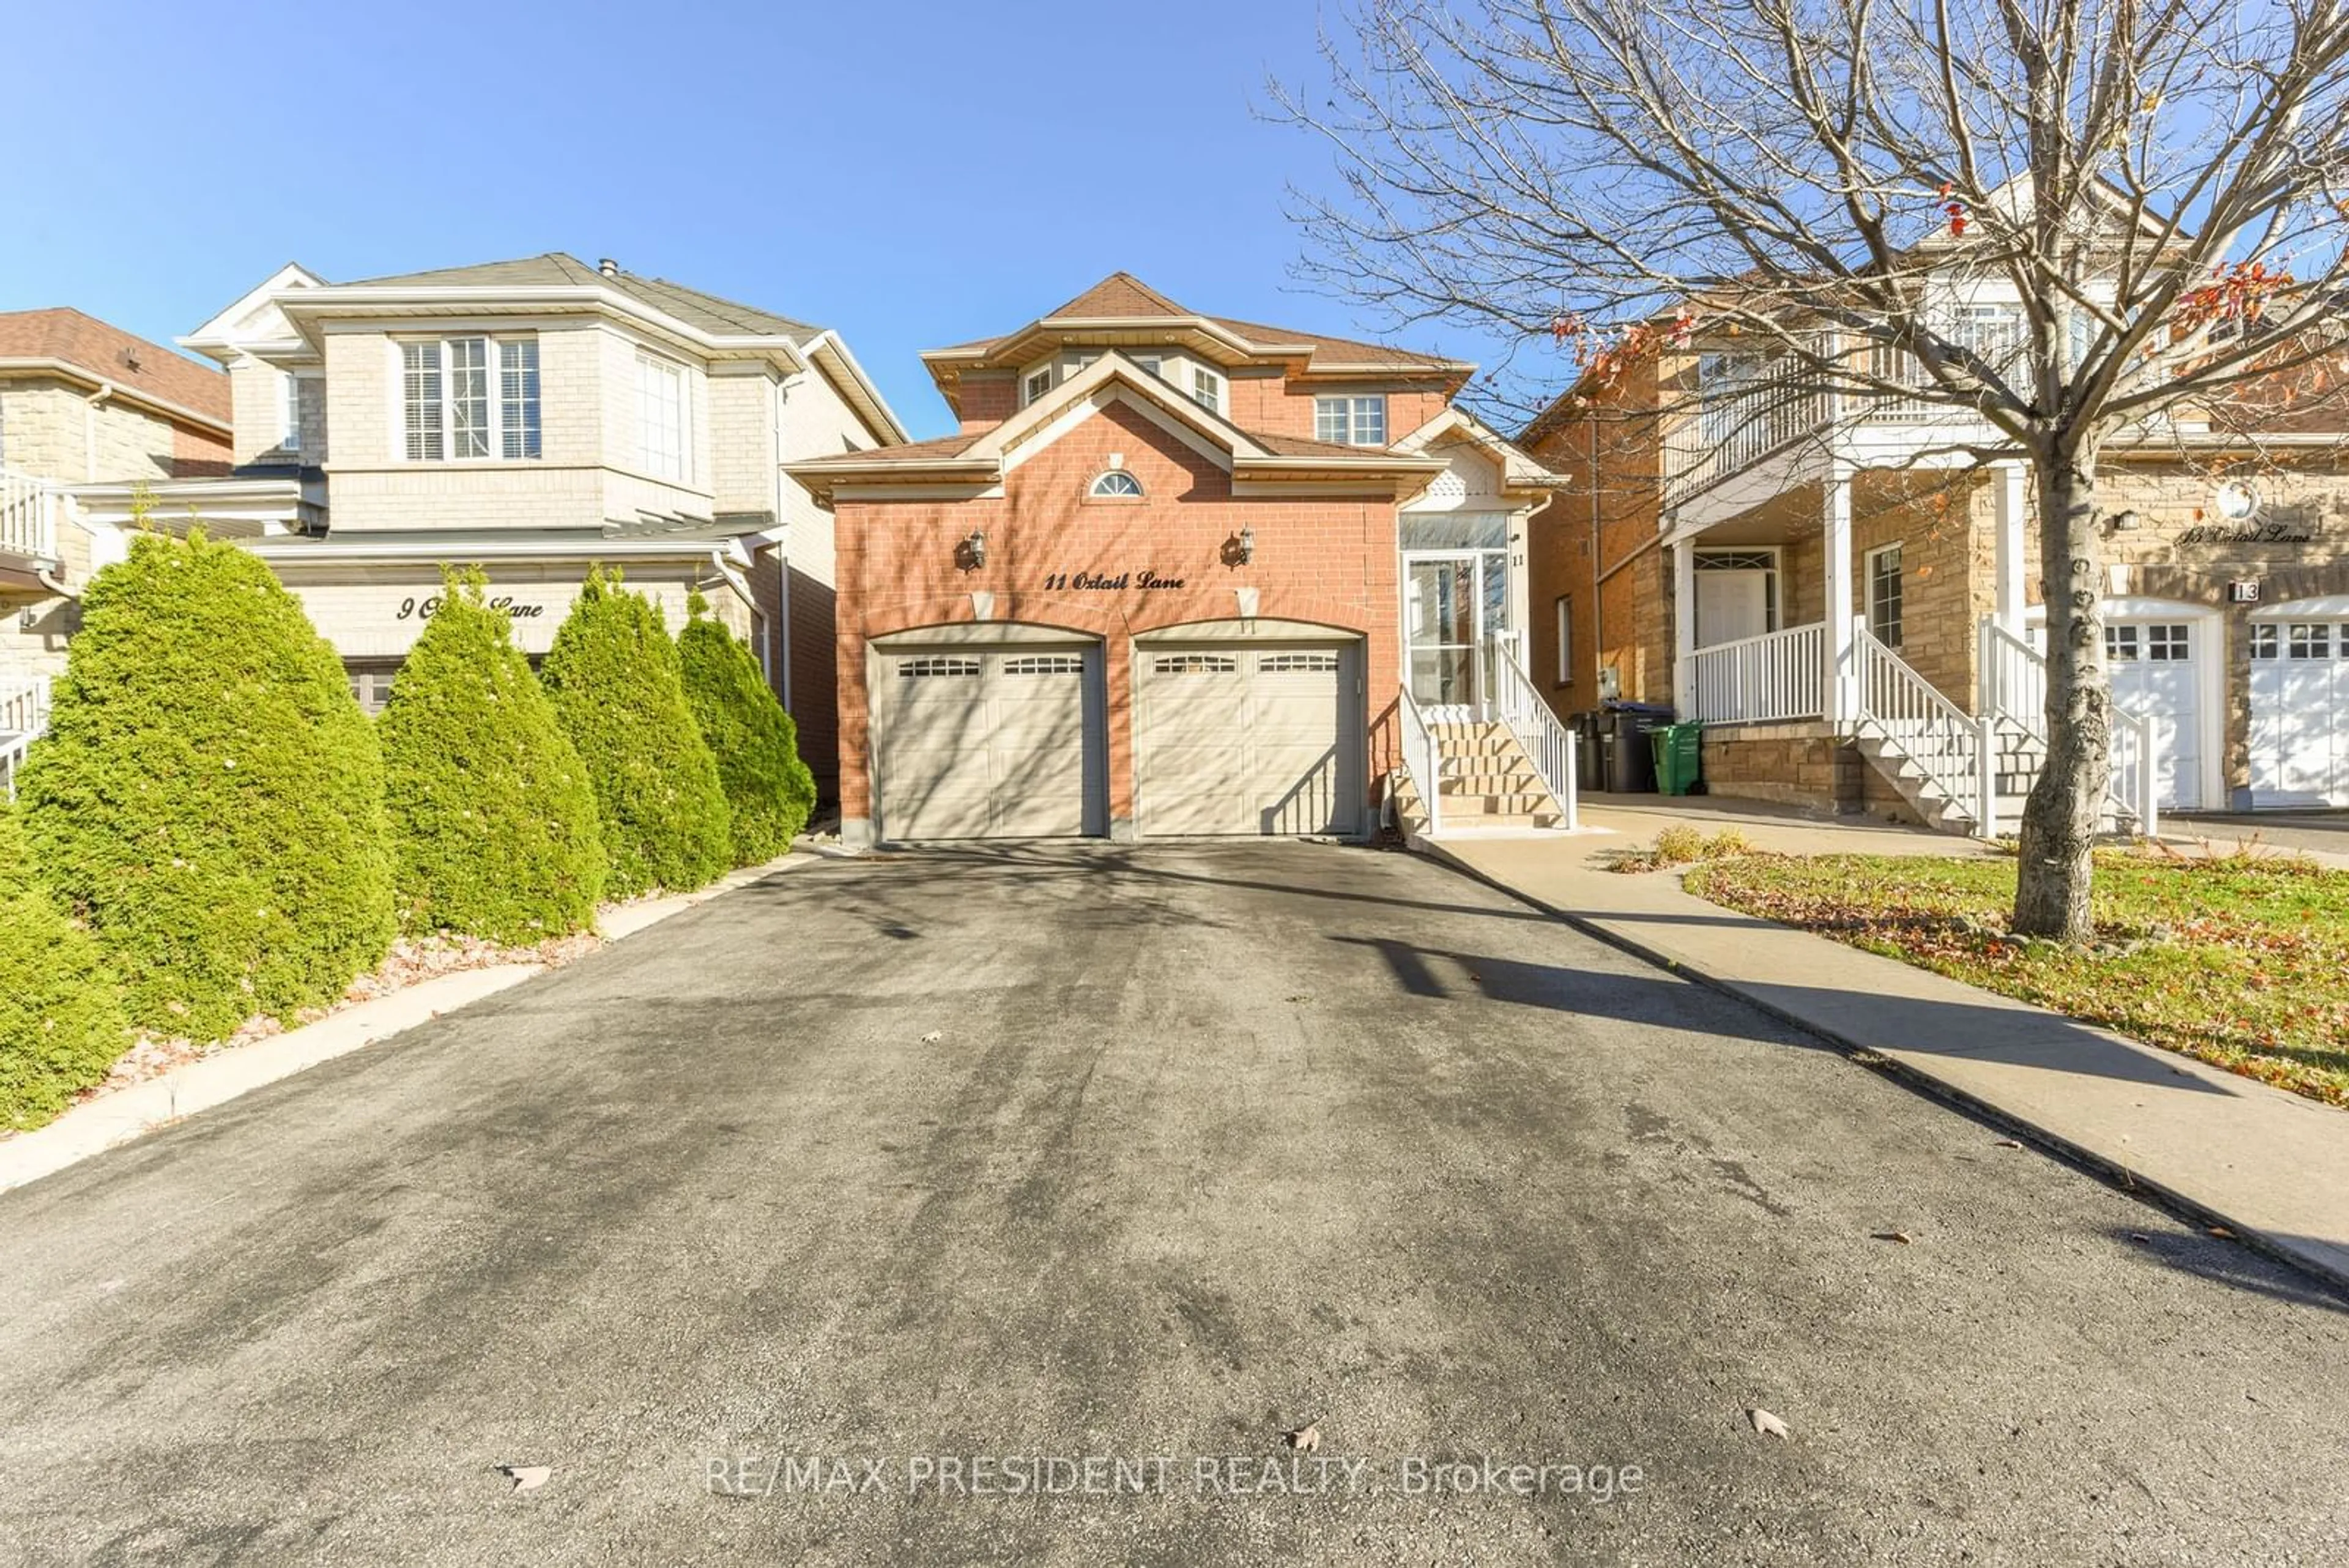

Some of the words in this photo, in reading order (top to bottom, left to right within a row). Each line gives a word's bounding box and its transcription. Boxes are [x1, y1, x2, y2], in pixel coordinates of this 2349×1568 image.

[2263, 523, 2310, 543] Lane
[1513, 554, 1523, 567] 11
[1045, 573, 1066, 590] 11
[1072, 571, 1129, 590] Oxtail
[1135, 570, 1186, 589] Lane
[2240, 584, 2258, 600] 13
[397, 597, 415, 620] 9
